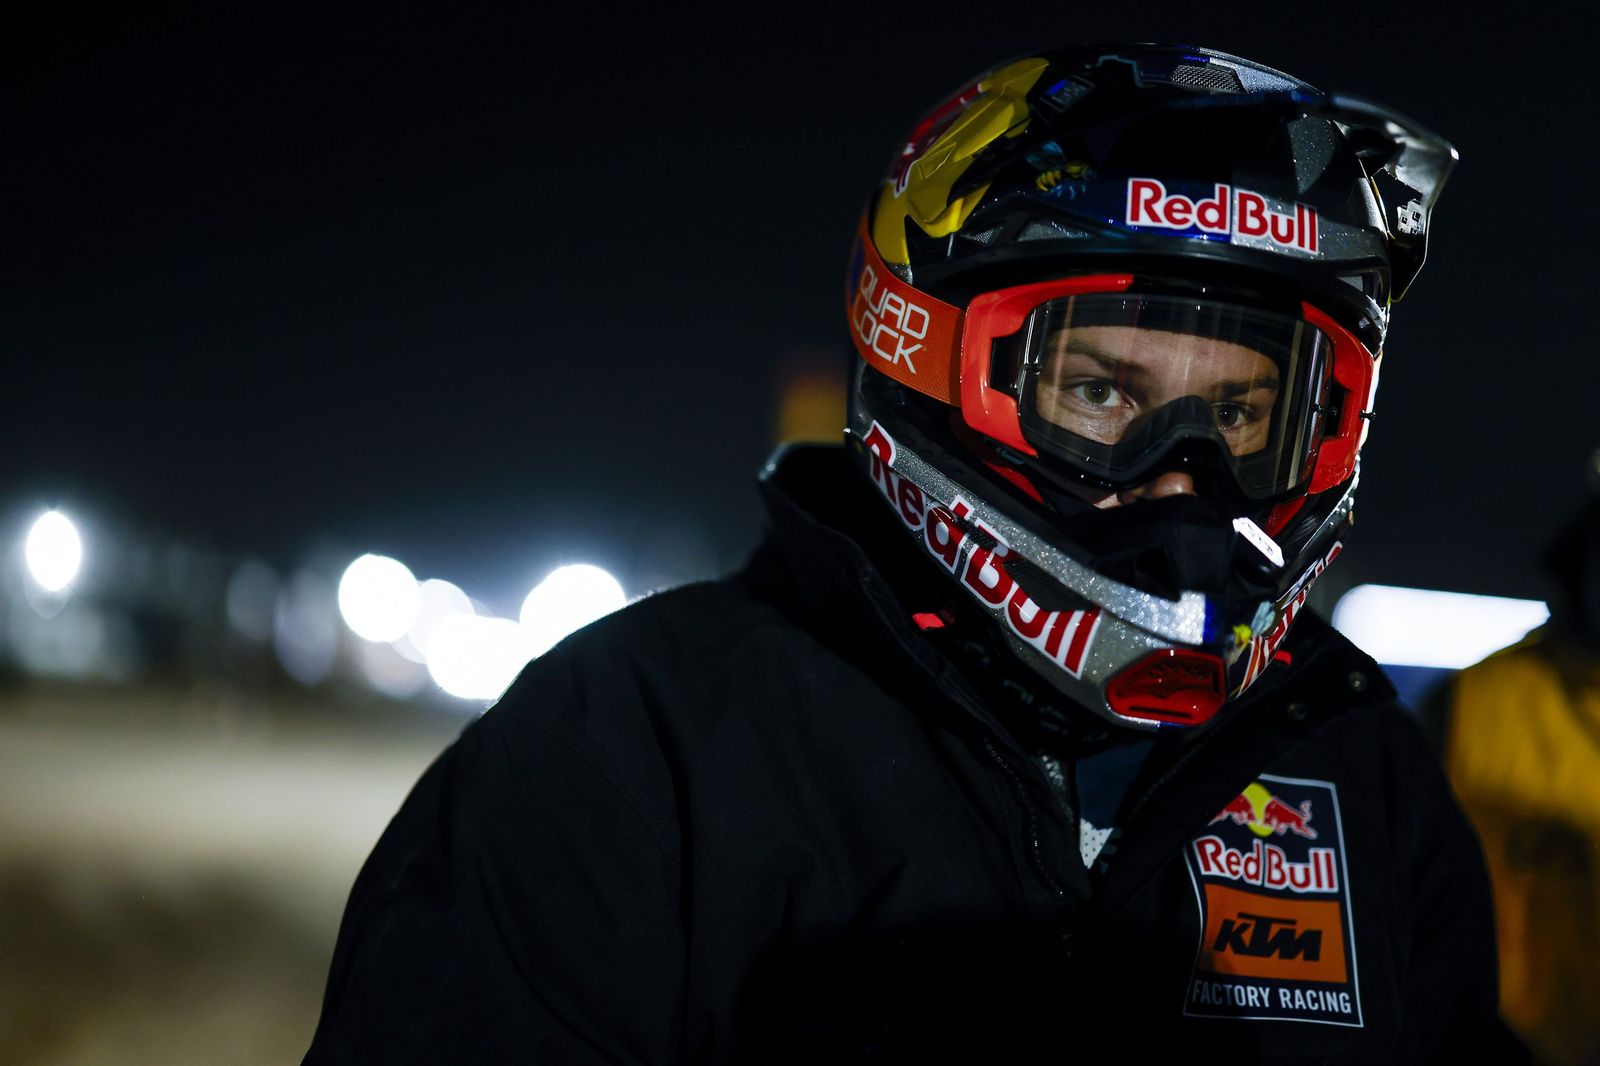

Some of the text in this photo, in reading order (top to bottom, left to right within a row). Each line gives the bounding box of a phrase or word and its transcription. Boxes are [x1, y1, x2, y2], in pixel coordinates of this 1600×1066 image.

[1127, 178, 1319, 256] Red Bull
[853, 293, 923, 374] LOCK
[861, 265, 930, 340] QUAD
[863, 420, 975, 574] Red
[960, 518, 1102, 680] Bull
[1193, 835, 1339, 893] Red Bull
[1215, 911, 1322, 962] KTM
[1192, 979, 1353, 1014] FACTORY RACING
